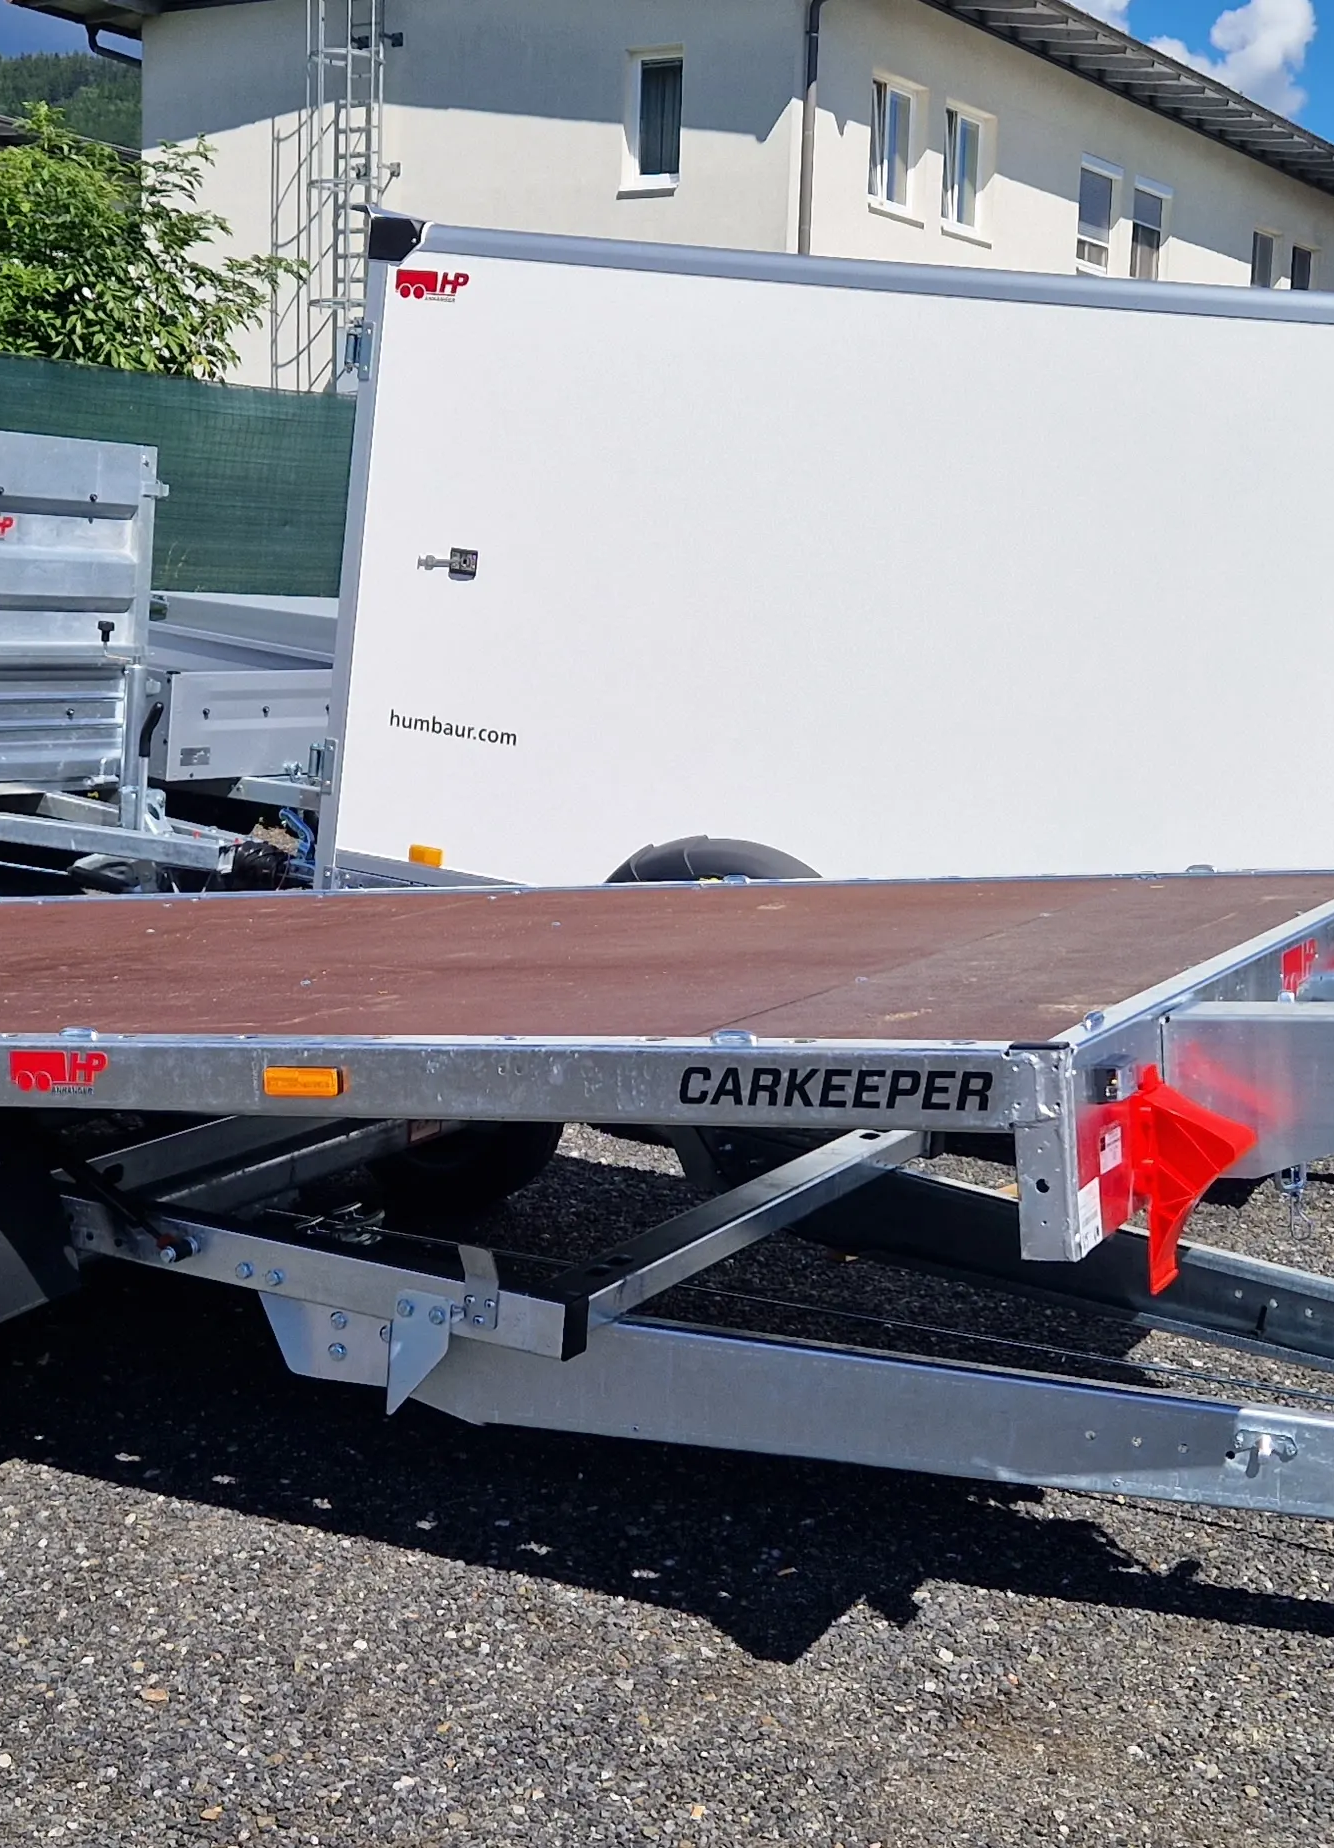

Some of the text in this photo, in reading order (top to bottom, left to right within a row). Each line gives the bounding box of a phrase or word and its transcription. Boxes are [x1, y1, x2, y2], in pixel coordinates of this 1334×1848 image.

[439, 271, 470, 294] HP
[389, 708, 517, 746] humbaur.com
[69, 1051, 108, 1083] HP
[678, 1066, 994, 1111] CARKEEPER
